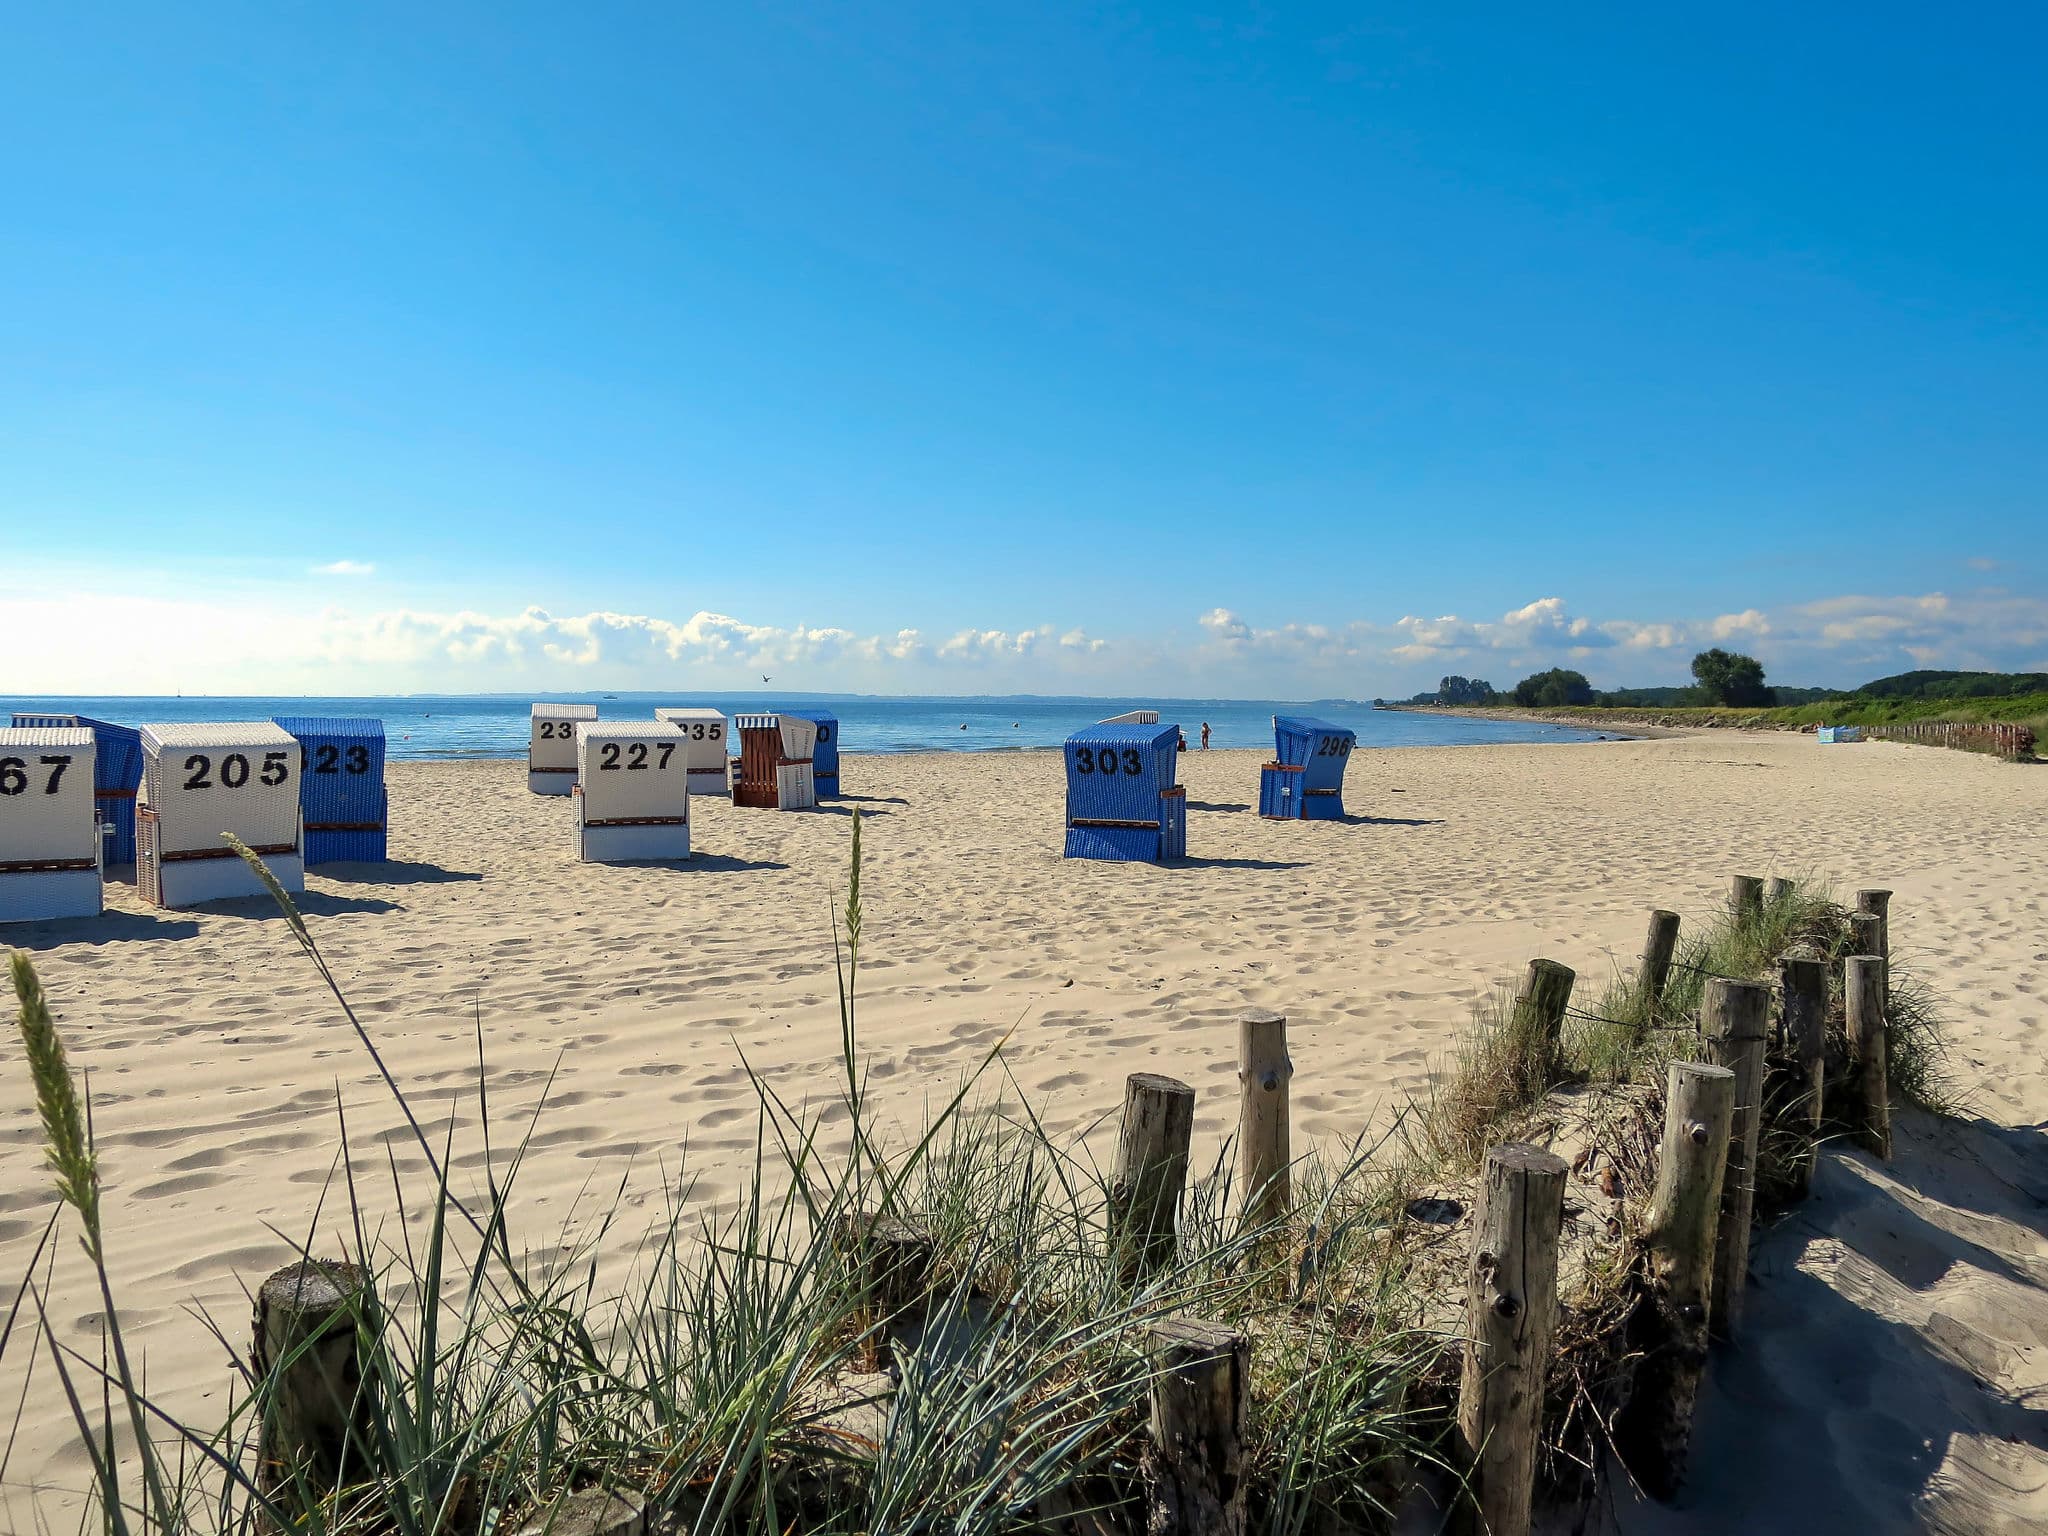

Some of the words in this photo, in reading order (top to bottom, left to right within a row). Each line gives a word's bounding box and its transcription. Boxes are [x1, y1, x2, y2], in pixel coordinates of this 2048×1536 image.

[541, 722, 577, 739] 23
[600, 742, 676, 770] 227
[1076, 747, 1142, 776] 303
[184, 752, 289, 790] 205
